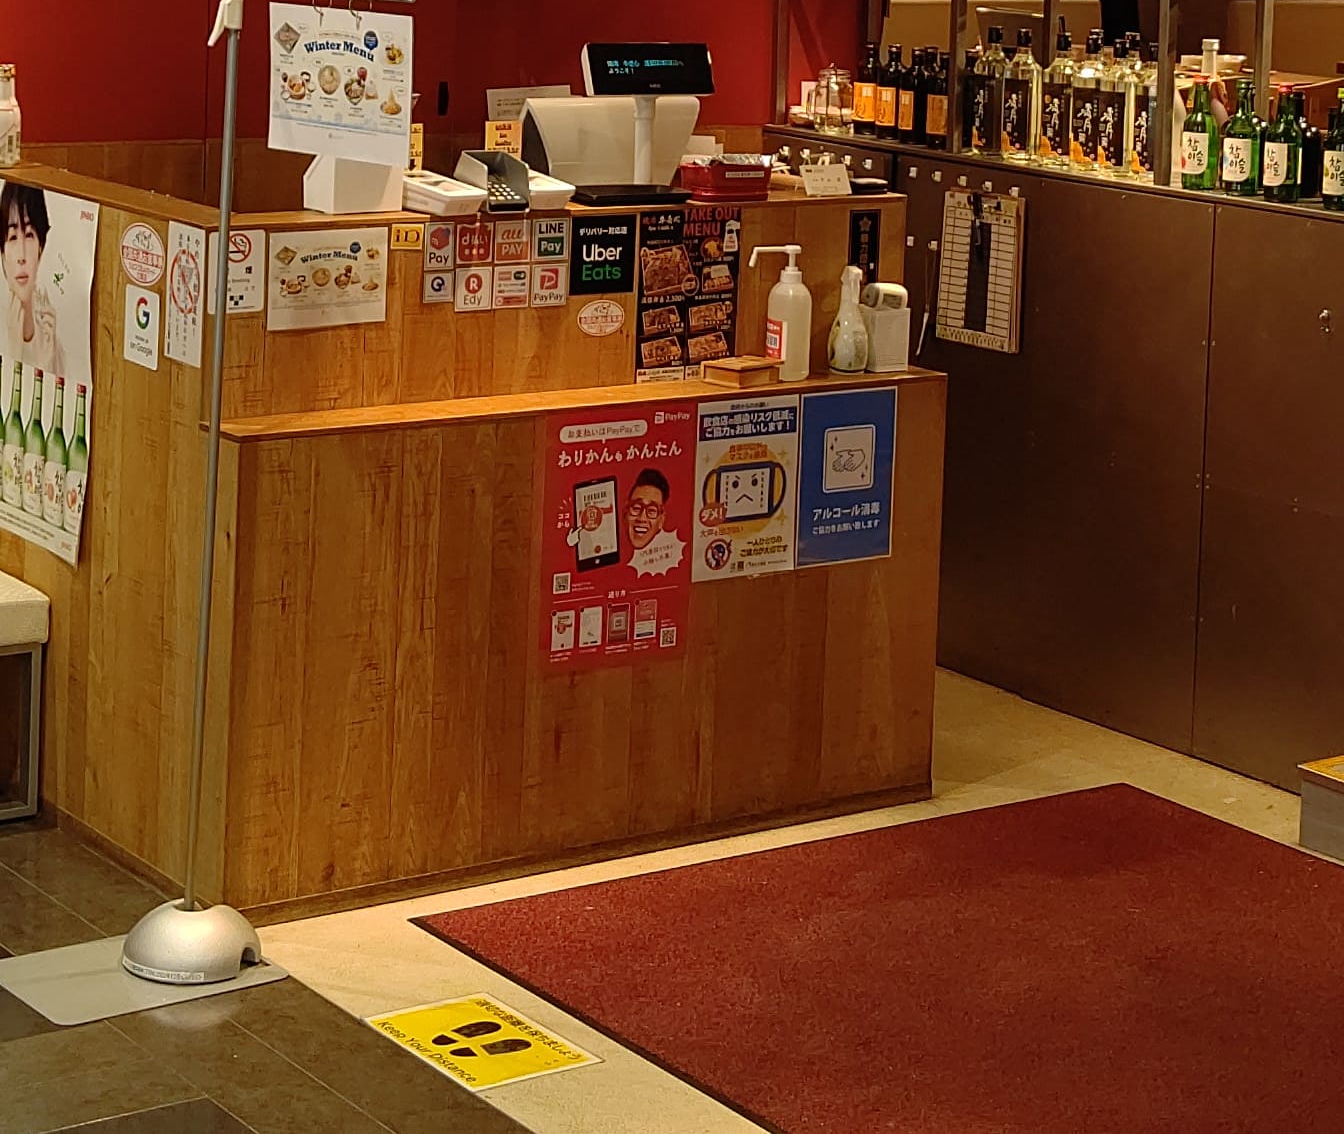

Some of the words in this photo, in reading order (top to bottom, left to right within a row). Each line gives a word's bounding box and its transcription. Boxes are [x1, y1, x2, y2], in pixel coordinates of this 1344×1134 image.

[304, 40, 341, 54] Winter
[343, 41, 374, 62] Menu
[683, 207, 713, 222] TAKE
[715, 207, 740, 220] OUT
[501, 227, 524, 241] au
[538, 222, 564, 235] LINE
[683, 222, 721, 237] MENU
[501, 244, 523, 256] PAY
[540, 241, 561, 254] Pay
[582, 244, 623, 262] Uber
[300, 253, 332, 264] Winter
[333, 251, 358, 262] Menu
[428, 252, 450, 266] Pay
[582, 264, 622, 281] Eats
[463, 294, 482, 306] Edy
[534, 292, 564, 302] PayPay
[665, 412, 690, 421] PayPay
[812, 502, 881, 520] アルコール消毒
[377, 1021, 406, 1039] Keep
[406, 1037, 431, 1054] Your
[428, 1049, 477, 1083] Distance
